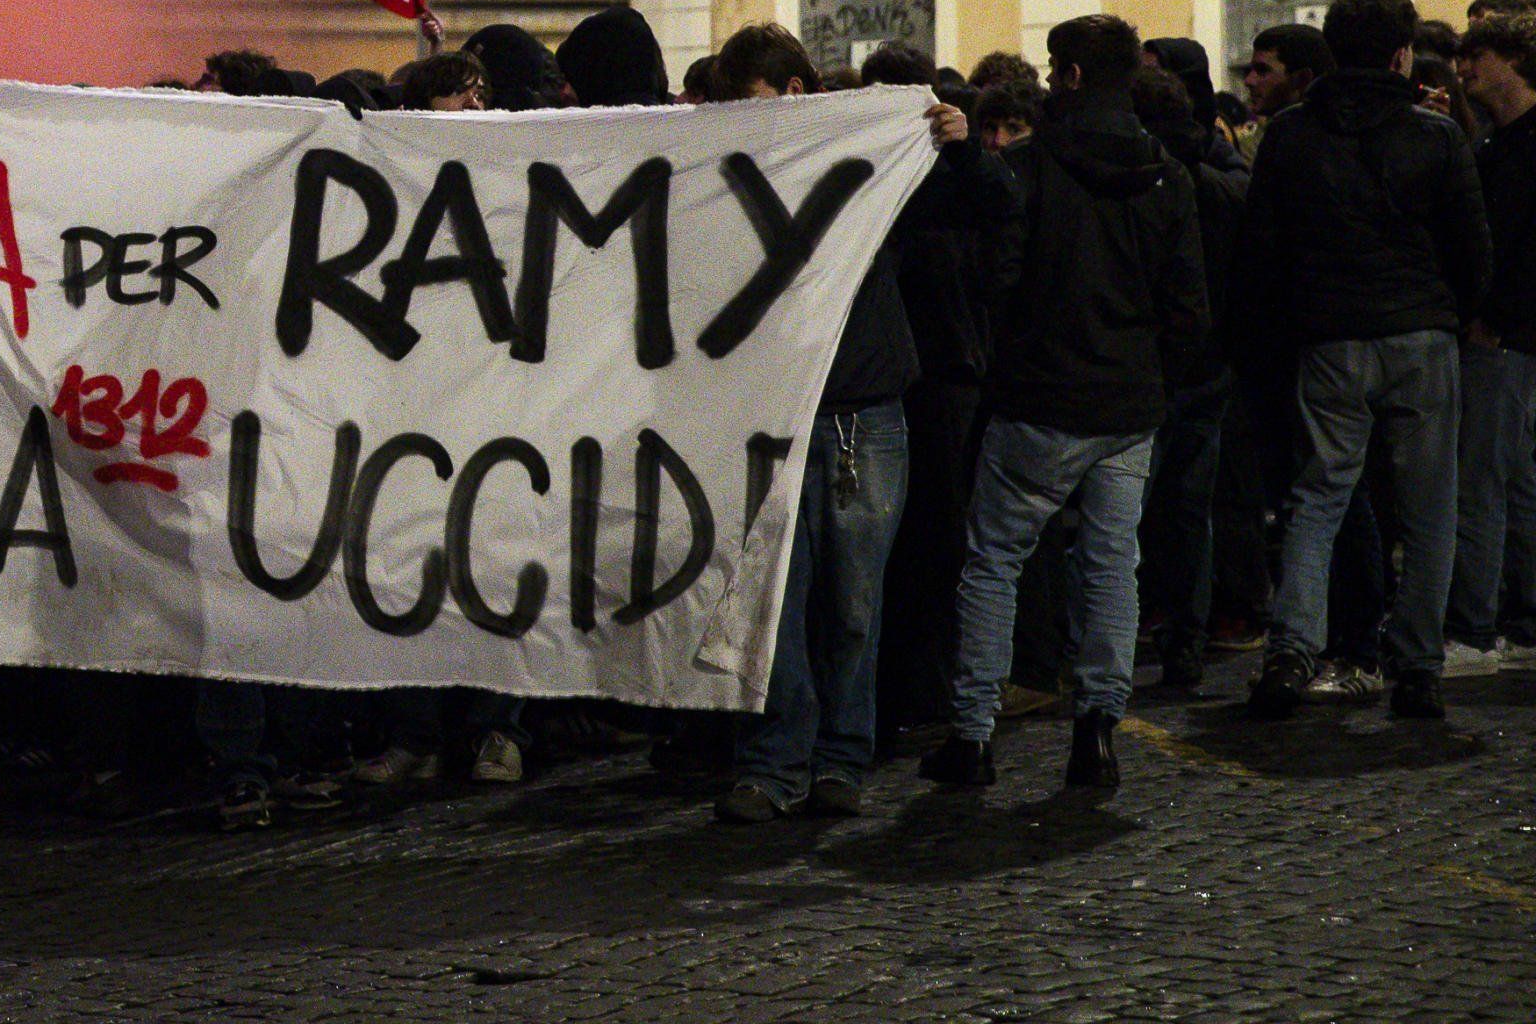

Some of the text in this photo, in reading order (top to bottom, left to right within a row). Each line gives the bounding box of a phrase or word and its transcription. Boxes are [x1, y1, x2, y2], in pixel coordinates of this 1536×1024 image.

[61, 225, 219, 310] PER
[275, 148, 875, 369] RAMY
[52, 365, 209, 458] 1312
